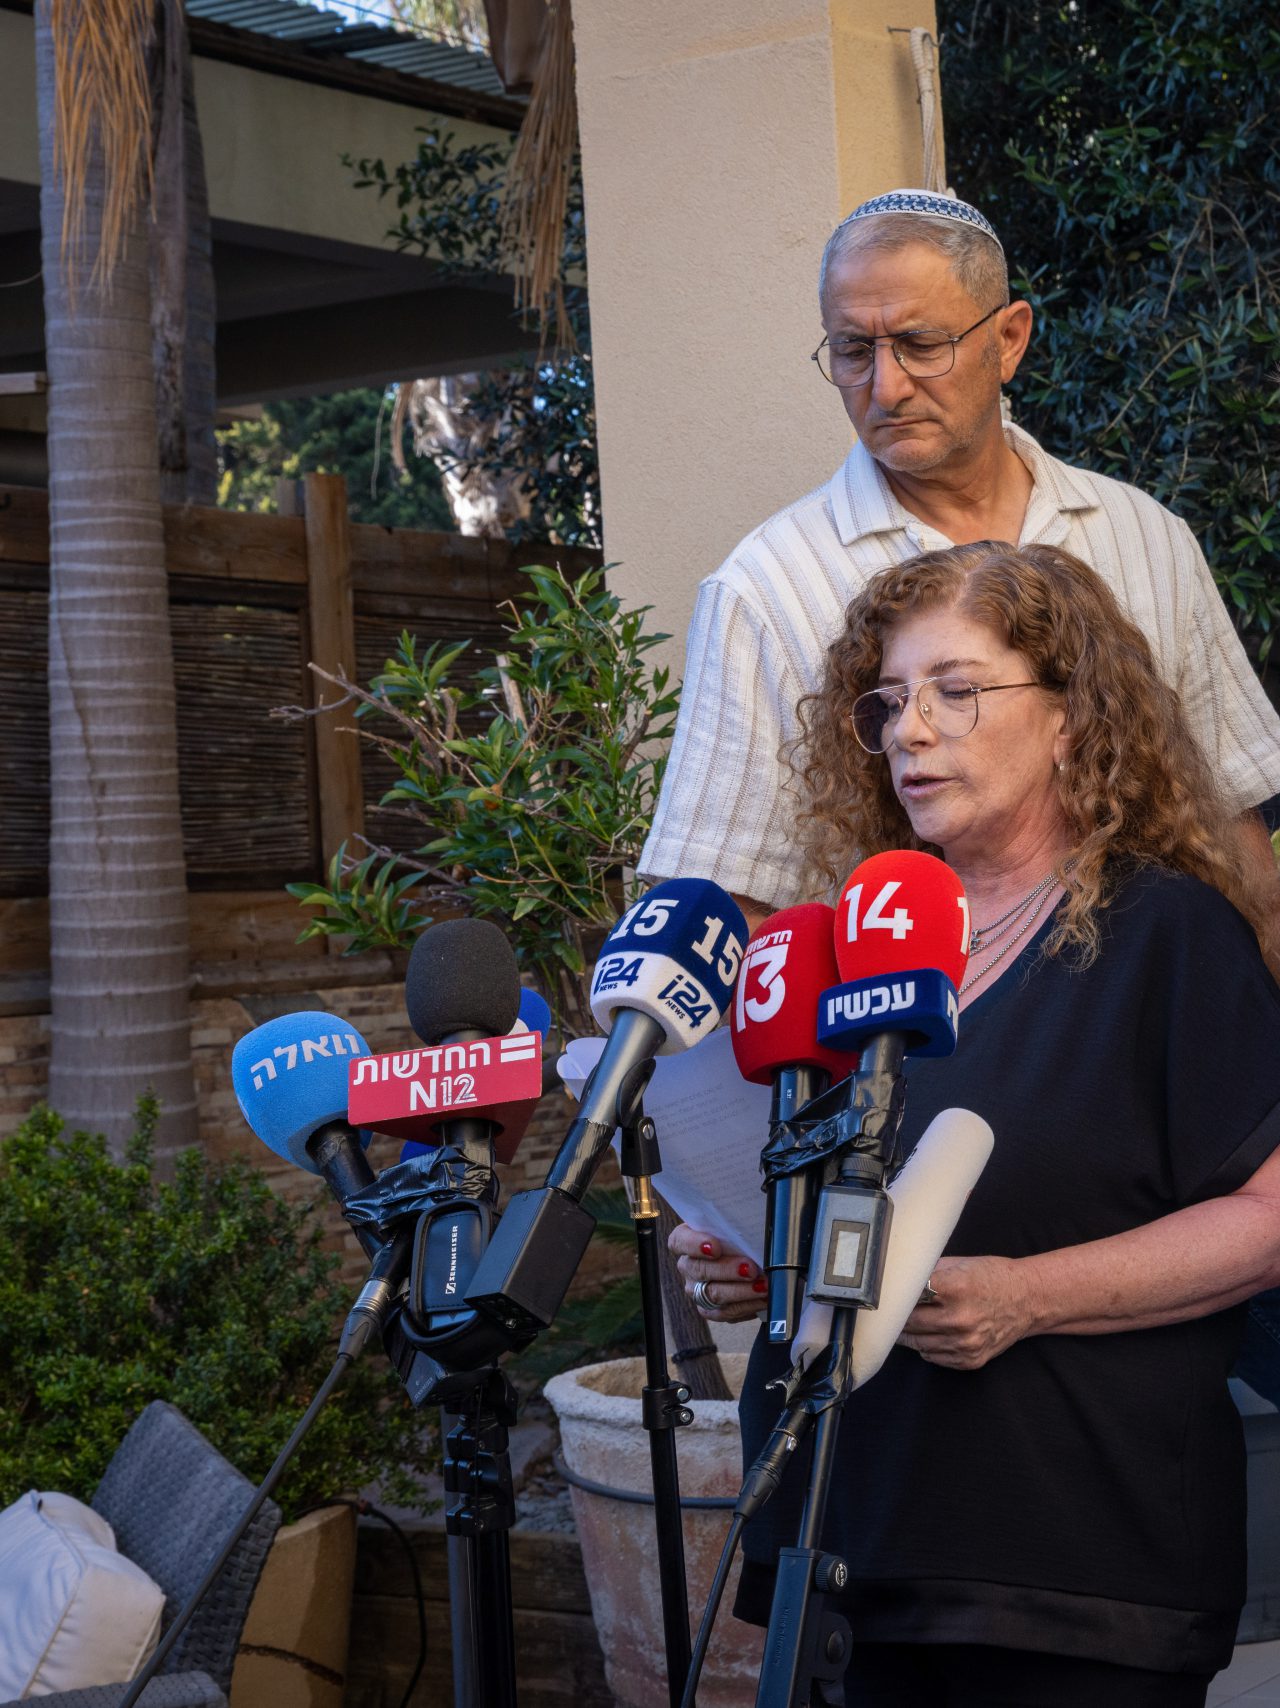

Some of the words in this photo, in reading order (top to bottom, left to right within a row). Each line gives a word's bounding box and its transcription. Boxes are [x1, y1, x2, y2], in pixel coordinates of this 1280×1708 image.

[609, 899, 680, 942] 15
[844, 881, 914, 943] 14
[691, 915, 744, 987] 15
[593, 957, 645, 996] i24
[599, 982, 618, 992] NEWS
[736, 943, 790, 1033] 13
[657, 974, 713, 1029] i24
[665, 999, 686, 1020] NEWS
[827, 980, 916, 1027] עכשיו
[353, 1041, 491, 1086] החדשות
[409, 1073, 478, 1112] N12
[448, 1225, 459, 1282] SENNHEISER
